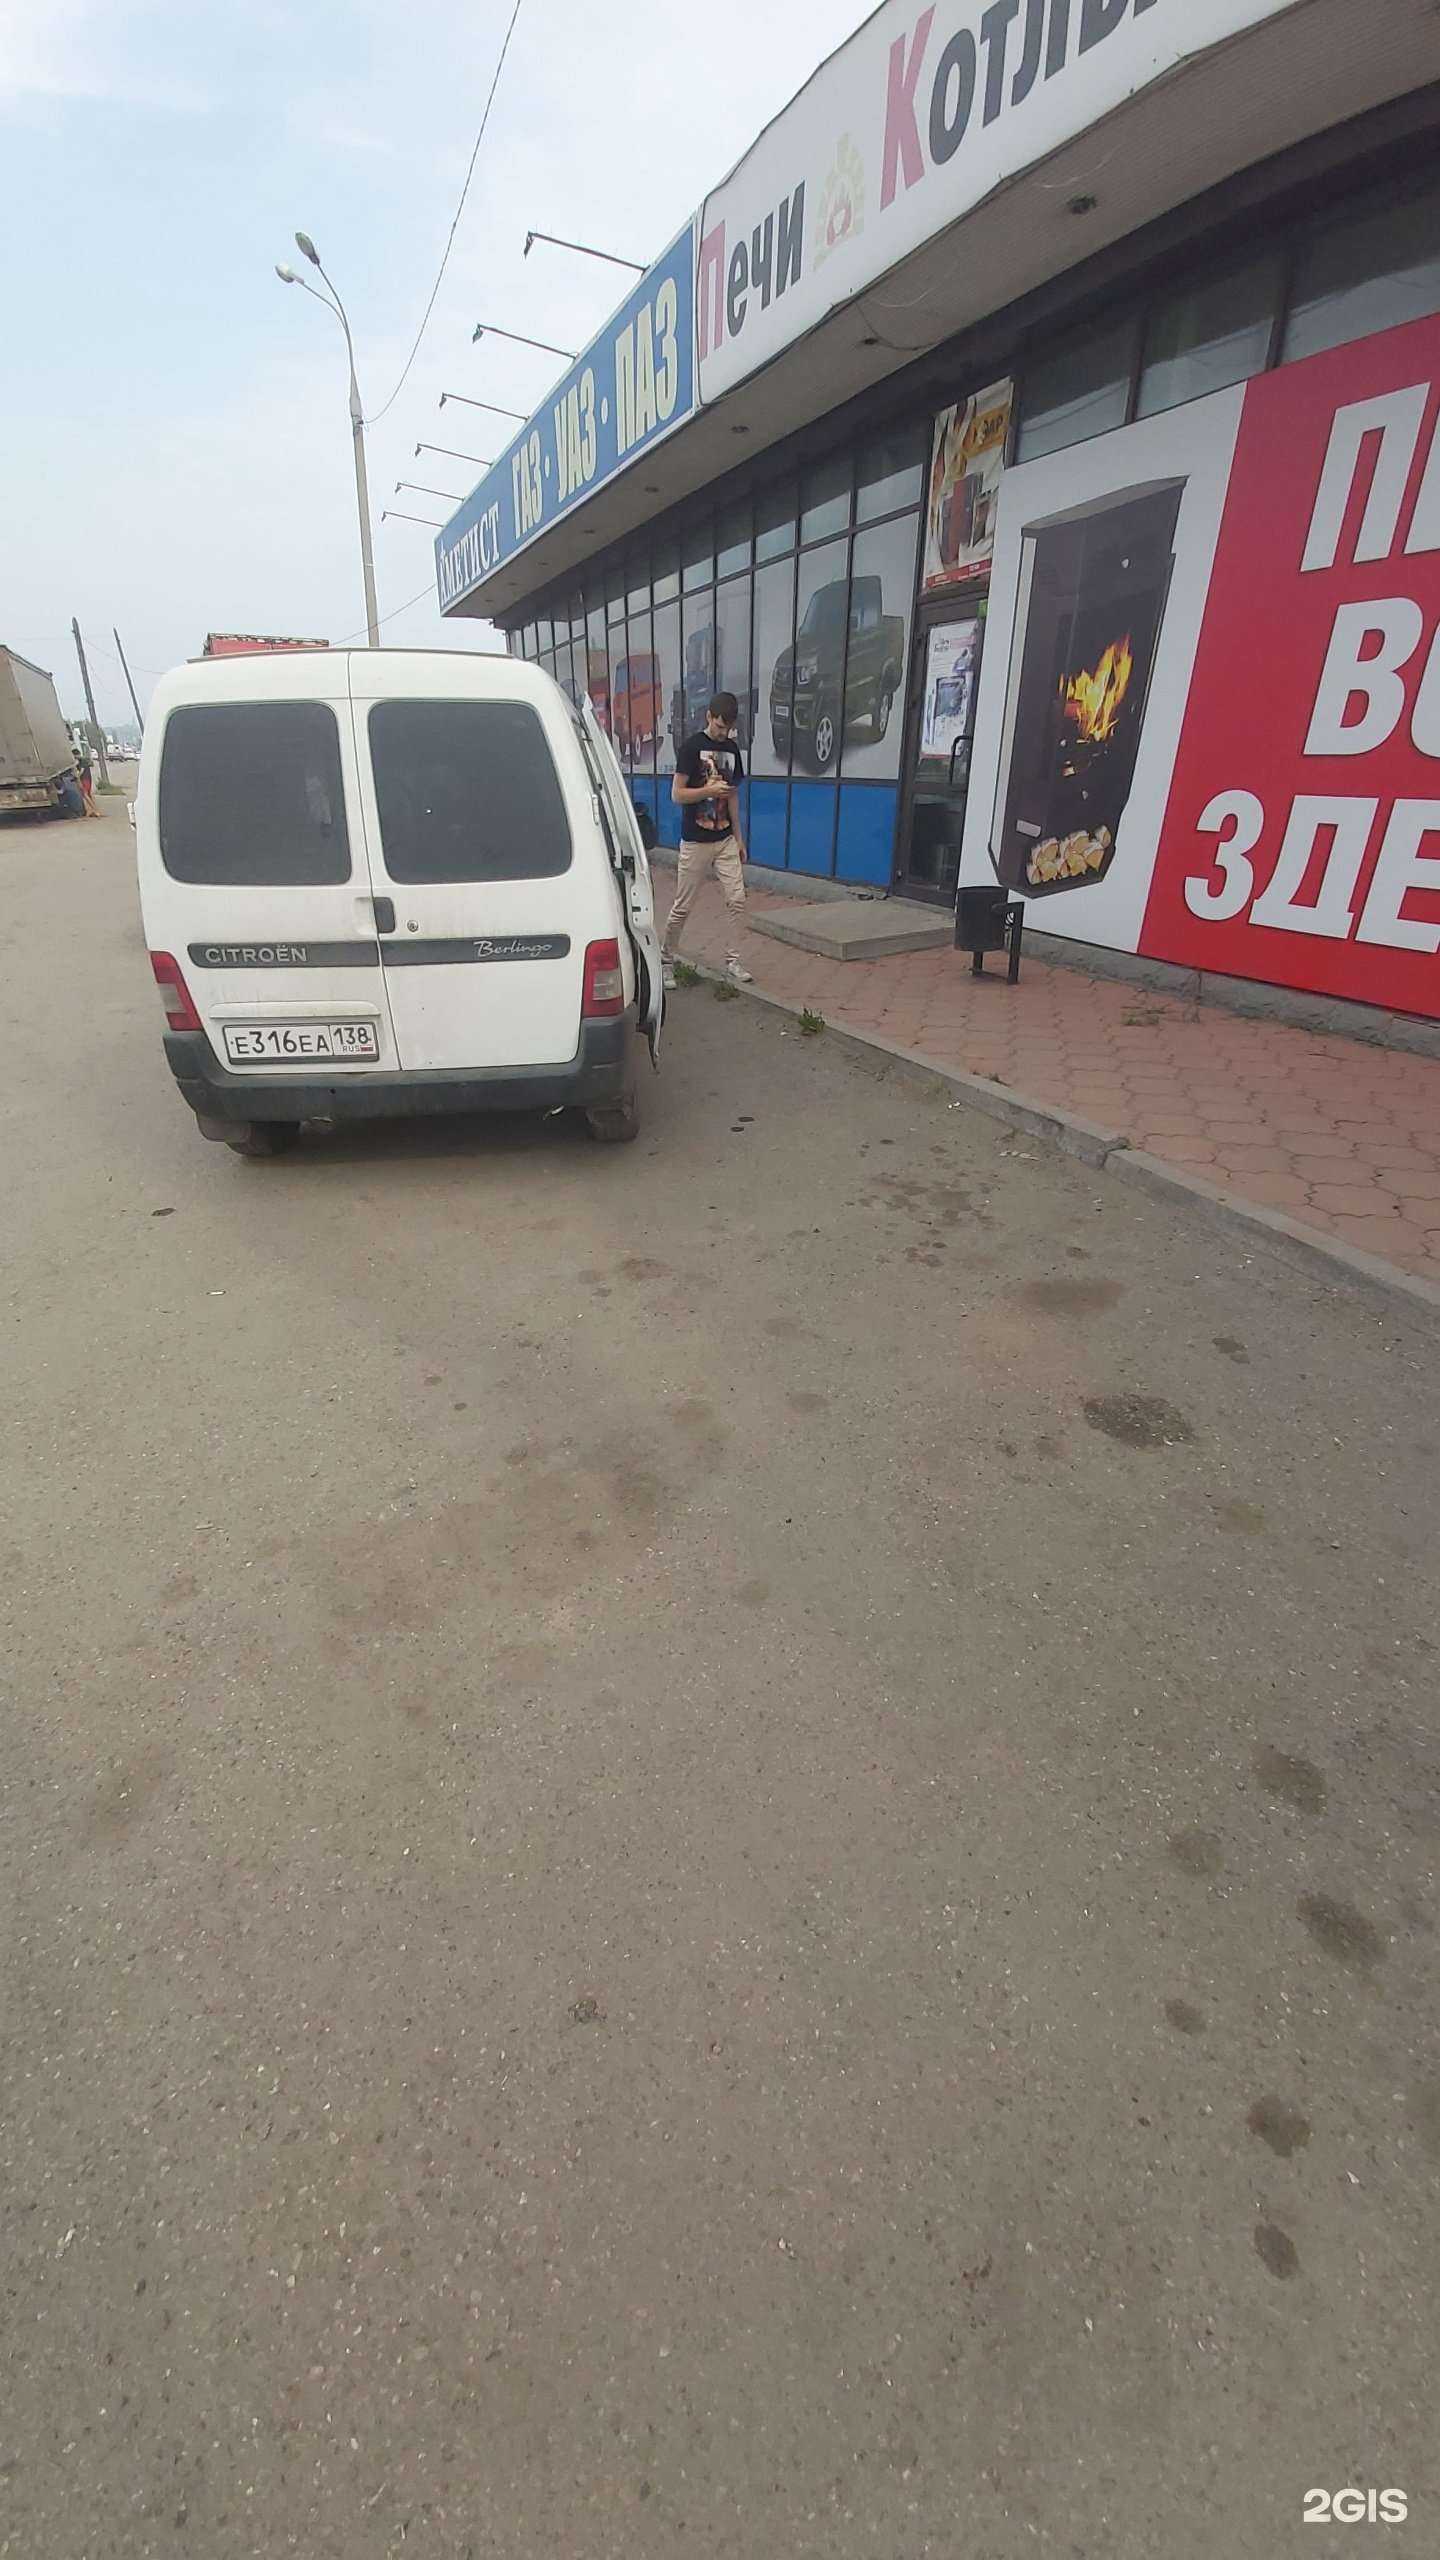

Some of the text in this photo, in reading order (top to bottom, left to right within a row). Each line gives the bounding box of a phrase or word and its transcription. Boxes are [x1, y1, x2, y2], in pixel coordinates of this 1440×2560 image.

[699, 179, 806, 363] Печи
[512, 429, 544, 540] ГАЗ
[554, 367, 598, 503] УАЗ
[615, 277, 678, 456] ПАЗ
[1301, 380, 1440, 573] П
[1303, 597, 1440, 758] В
[205, 944, 308, 963] CITROËN
[473, 939, 553, 958] Berlingo
[333, 1027, 369, 1044] 138
[342, 1045, 361, 1053] RUS
